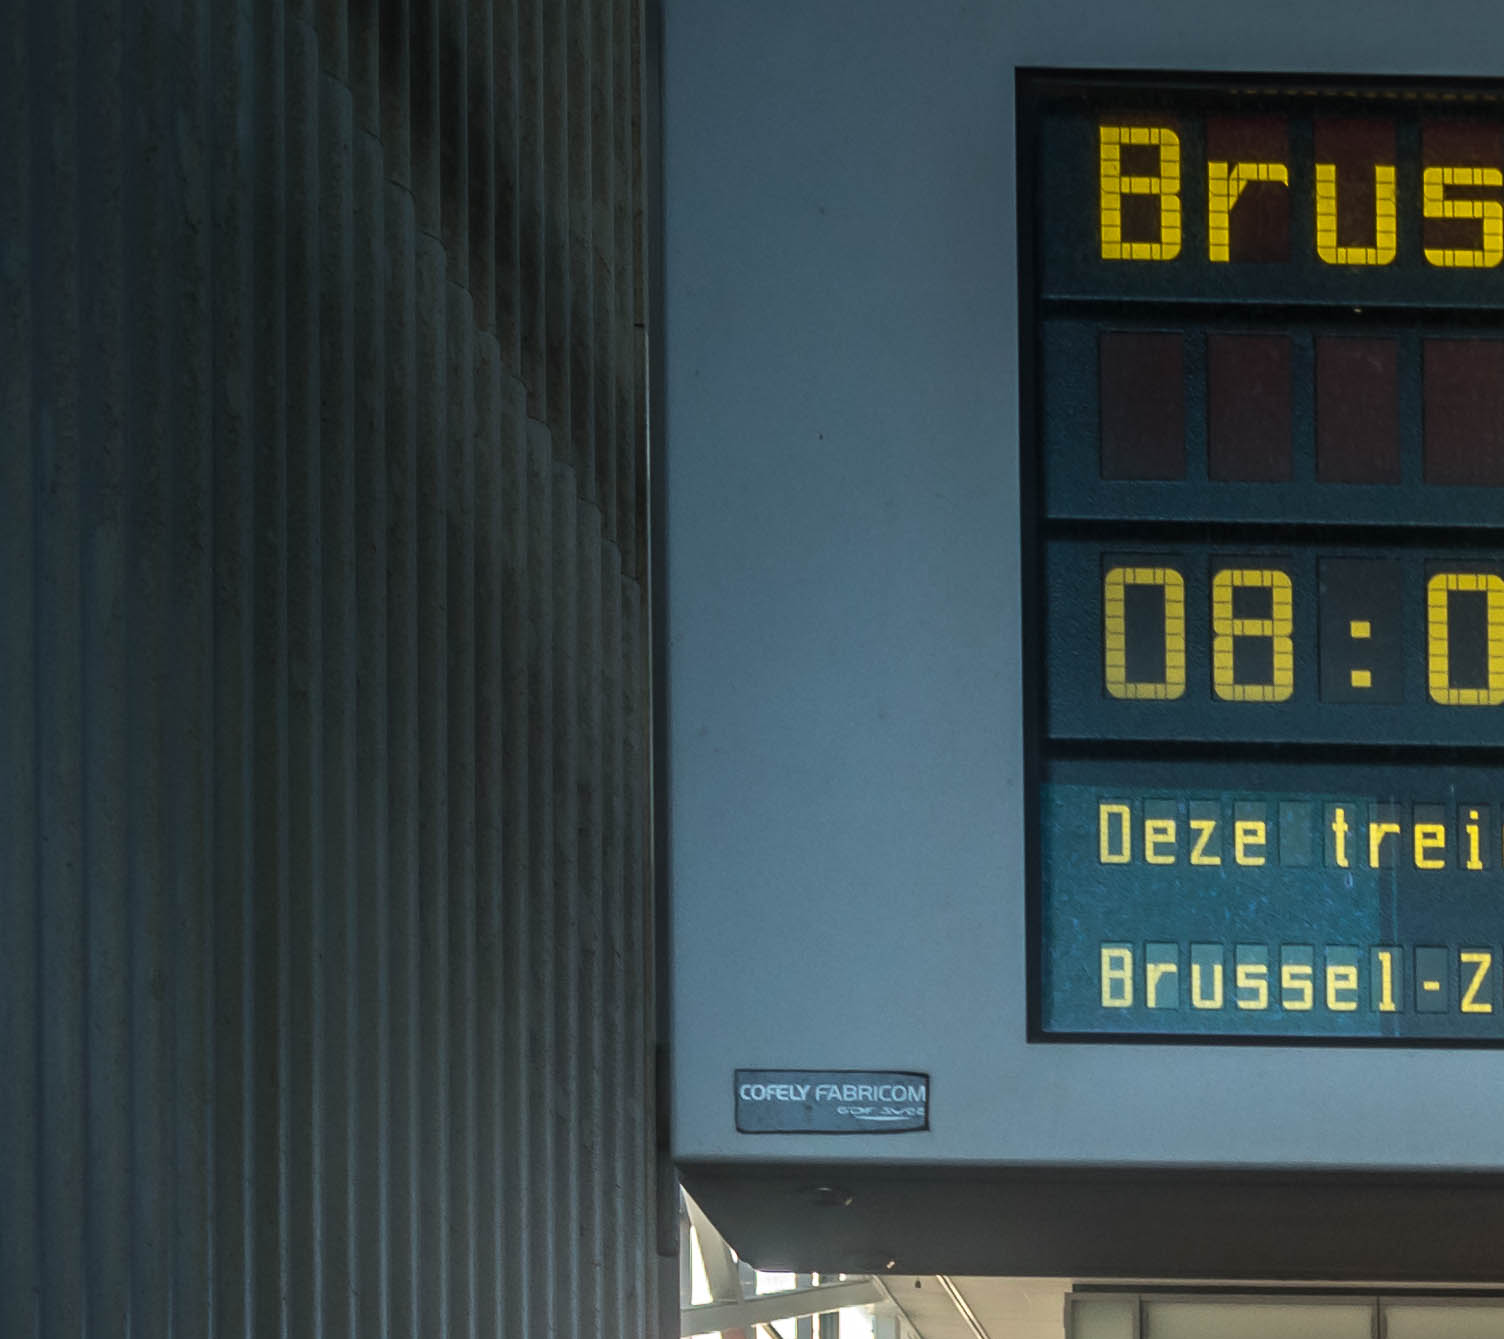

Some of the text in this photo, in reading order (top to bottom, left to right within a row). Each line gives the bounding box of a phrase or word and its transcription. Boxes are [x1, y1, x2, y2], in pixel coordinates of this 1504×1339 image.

[1099, 803, 1267, 867] Deze
[740, 1084, 926, 1101] COFELY FABRICOM
